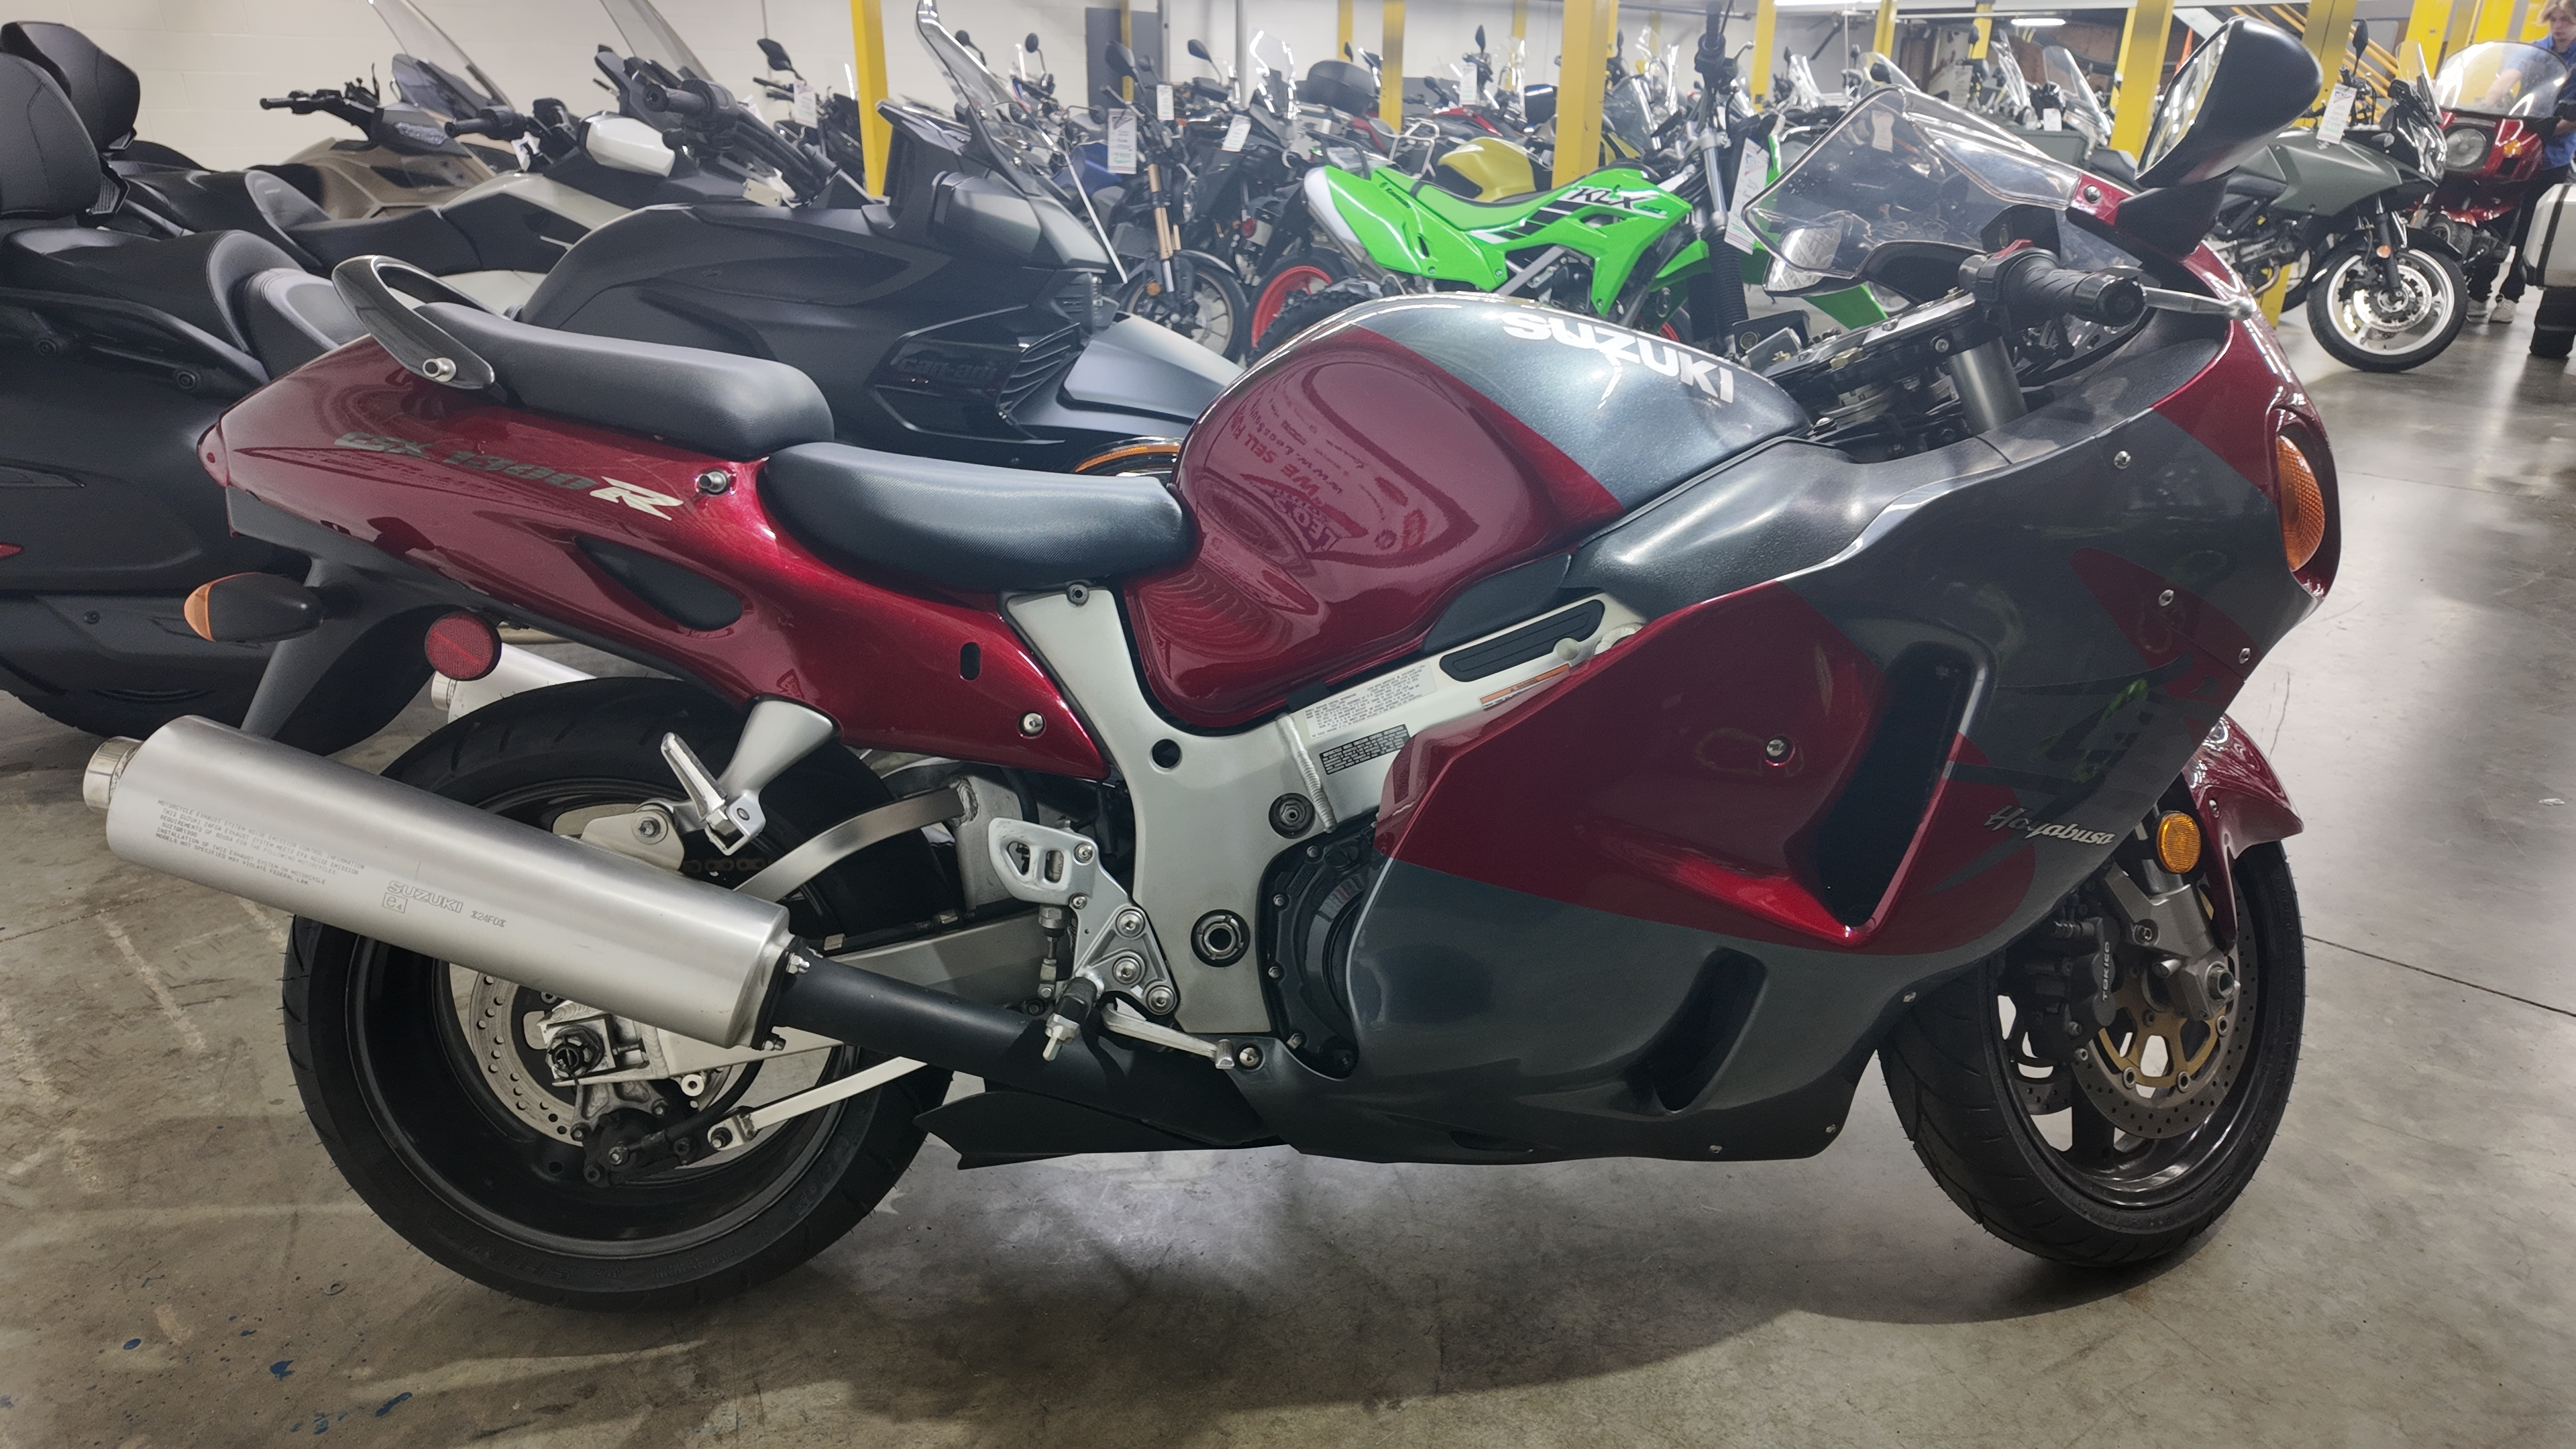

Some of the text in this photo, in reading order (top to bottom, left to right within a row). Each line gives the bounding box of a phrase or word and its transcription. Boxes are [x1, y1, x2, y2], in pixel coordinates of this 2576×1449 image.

[1566, 187, 1649, 211] KLX
[1501, 311, 1734, 403] SUZUKI
[1243, 433, 1278, 465] SELL
[590, 476, 684, 521] R
[158, 800, 194, 816] MOTORCYCLE
[196, 812, 221, 824] EXHAUST
[224, 820, 246, 831] SYSTEM
[160, 814, 203, 833] REQUIREMENTS
[1984, 805, 2115, 845] Hayabusa
[156, 833, 177, 844] MODELS
[195, 845, 226, 859] SPECIFIED
[157, 826, 199, 844] INSTALLATION
[162, 808, 177, 817] THIS
[179, 814, 201, 825] SUZUKI
[224, 828, 250, 840] EXHAUST
[310, 855, 328, 865] NOISE
[330, 862, 359, 875] EMISSION
[387, 880, 464, 914] SUZUKI
[2102, 941, 2110, 1001] TOKICO
